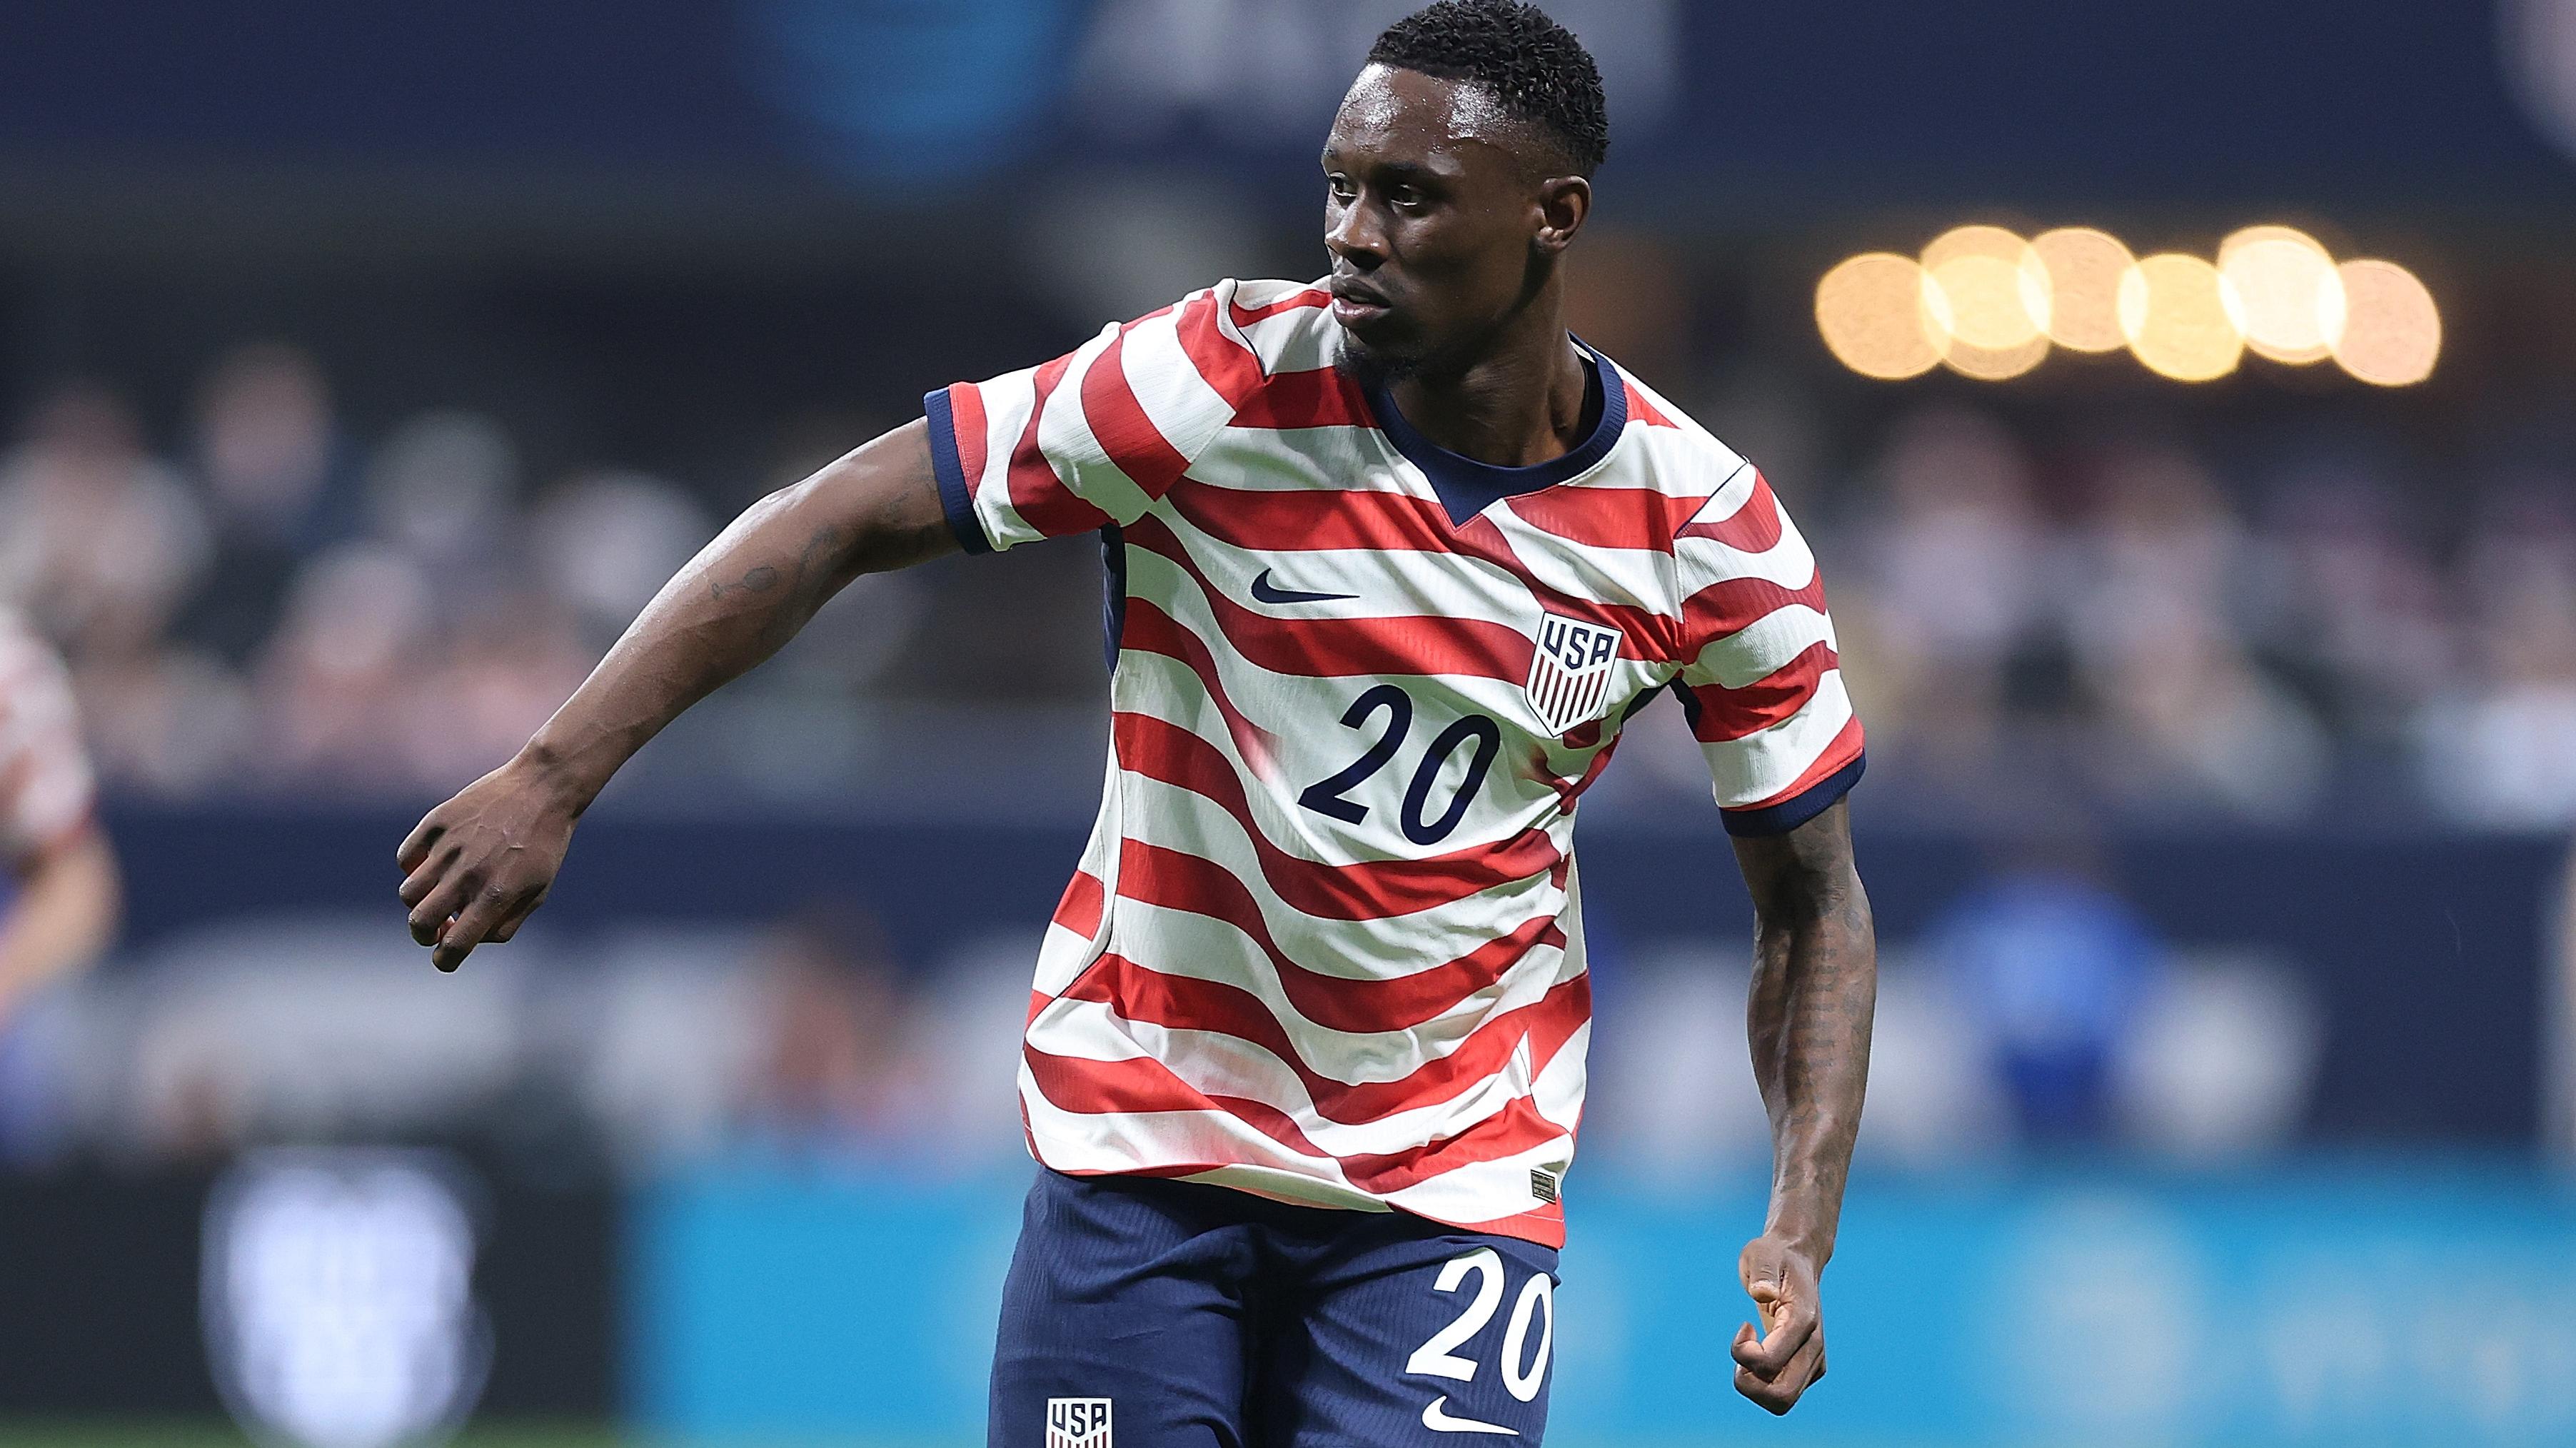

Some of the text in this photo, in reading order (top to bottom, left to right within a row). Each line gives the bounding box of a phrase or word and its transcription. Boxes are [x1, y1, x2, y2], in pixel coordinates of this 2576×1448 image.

[1544, 620, 1614, 670] USA
[1297, 684, 1500, 845] 20
[1405, 1247, 1552, 1402] 20
[1052, 1403, 1107, 1437] USA
